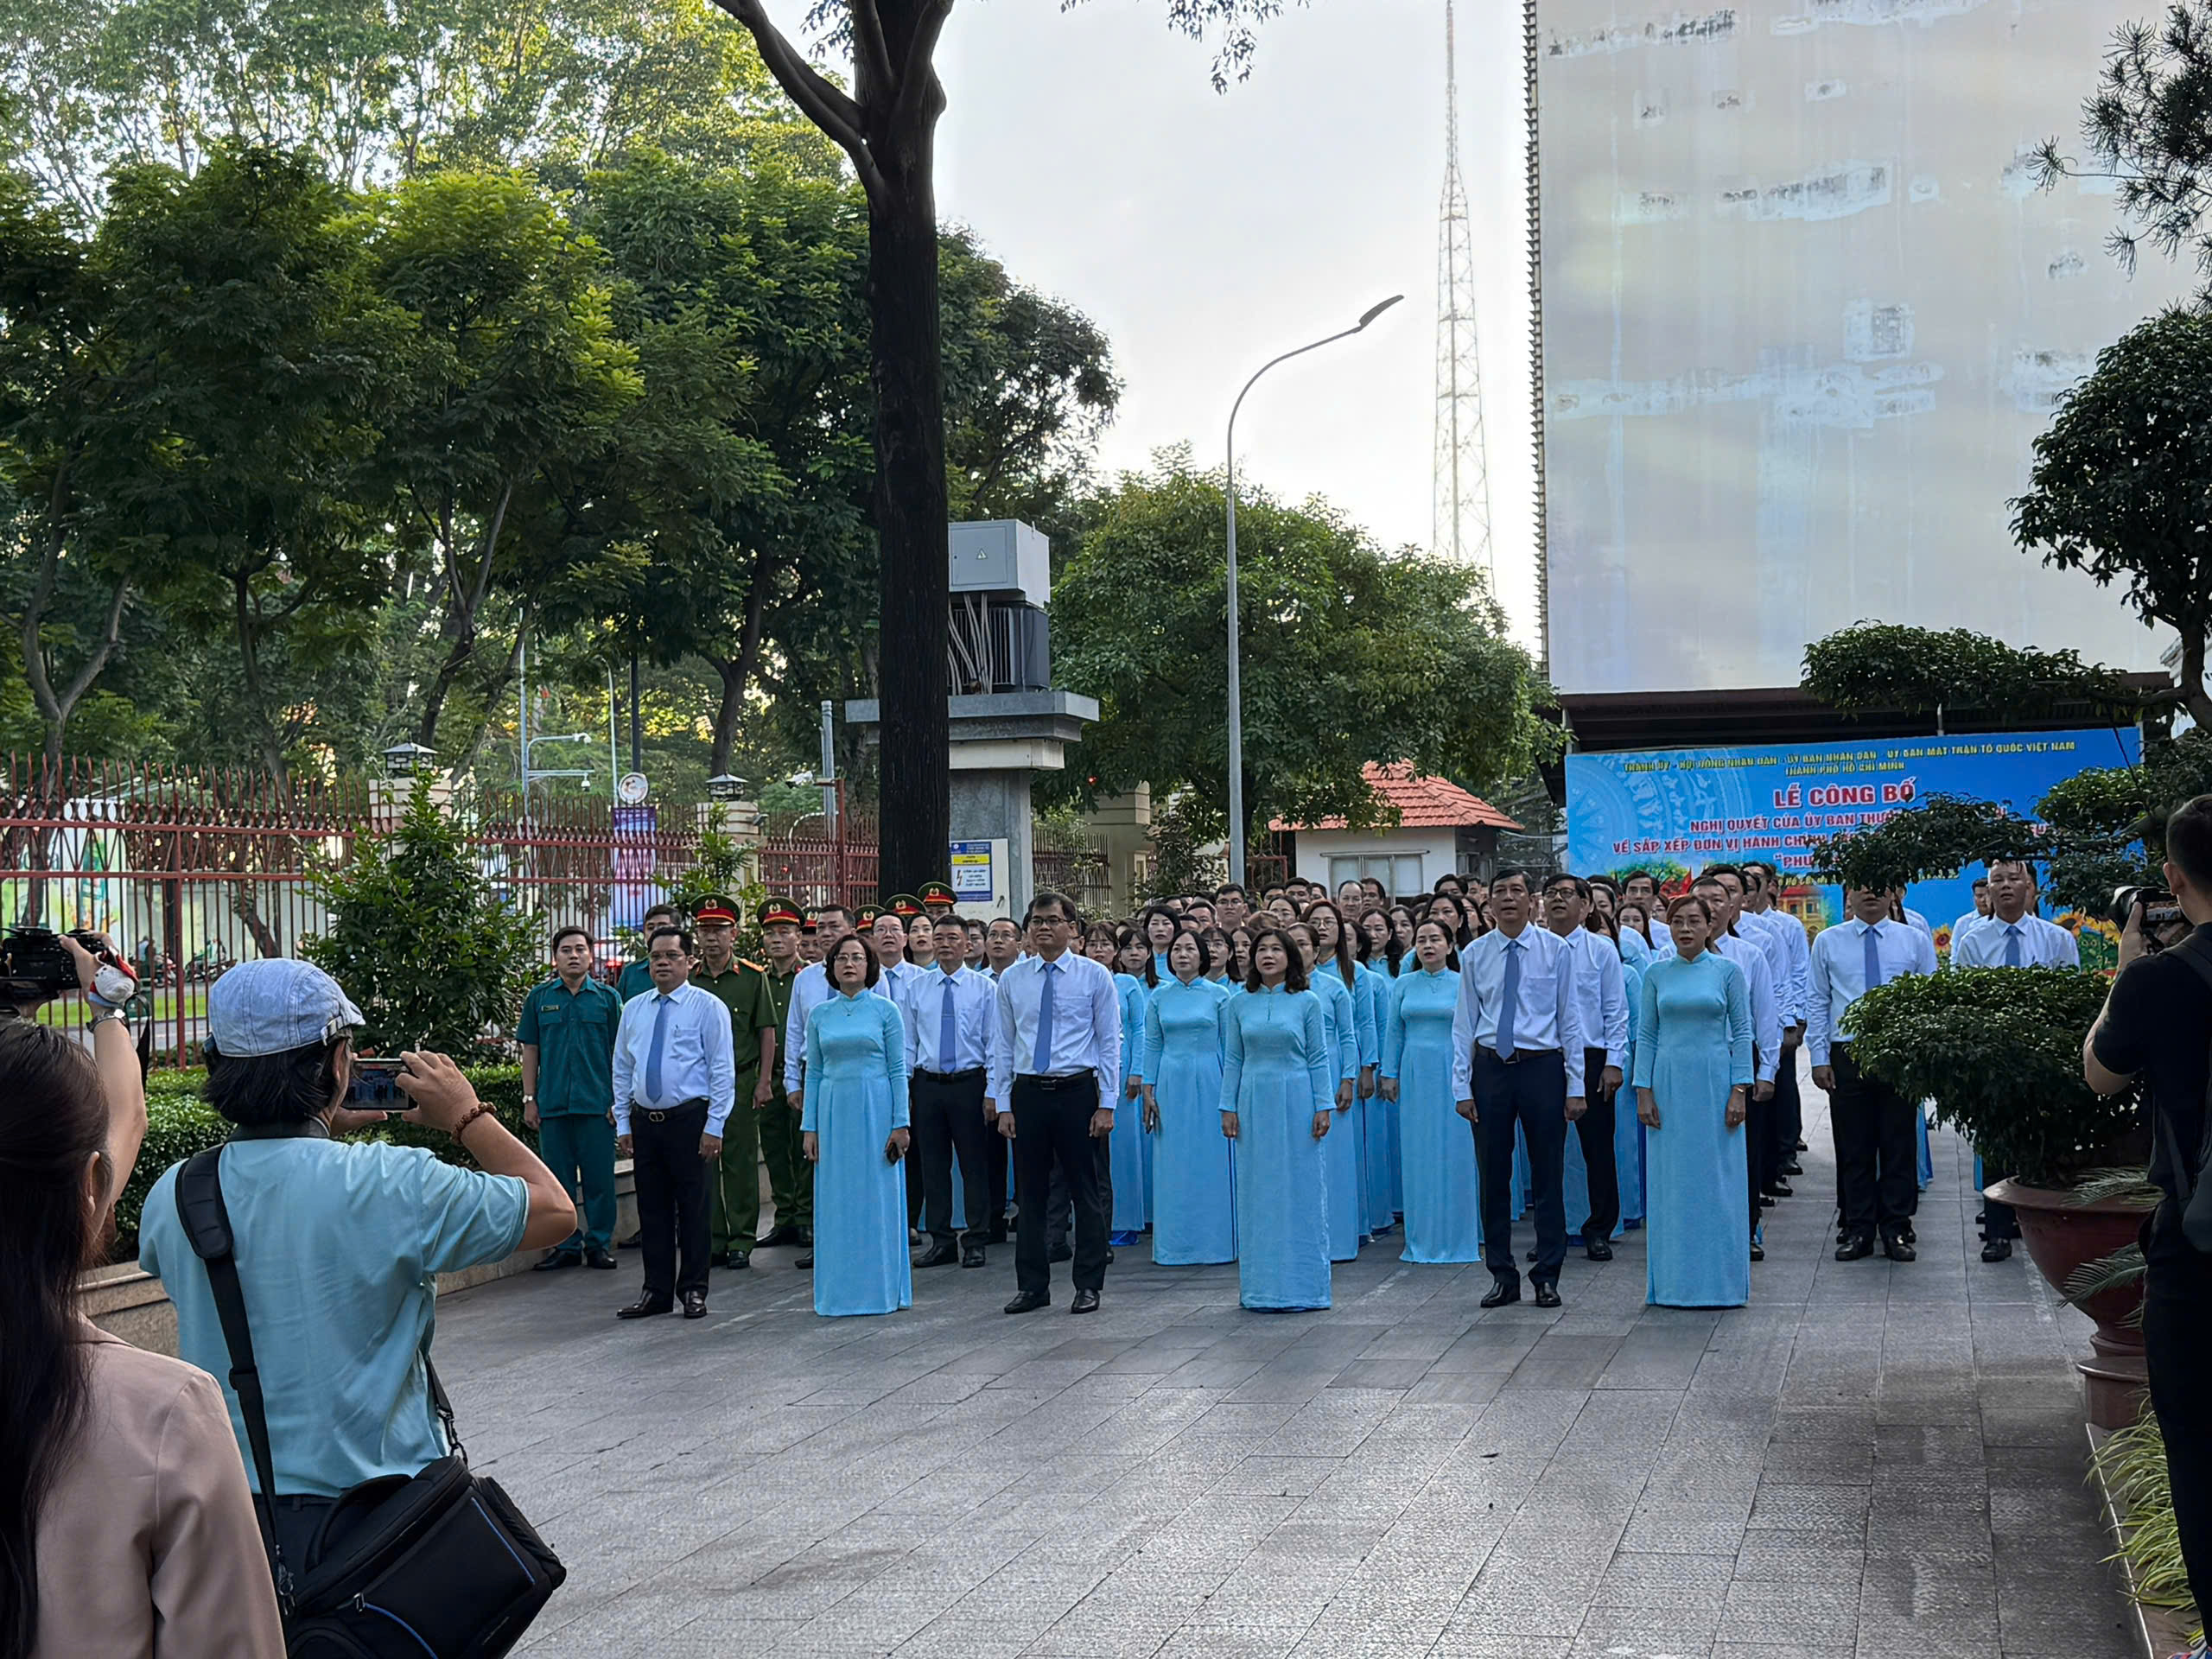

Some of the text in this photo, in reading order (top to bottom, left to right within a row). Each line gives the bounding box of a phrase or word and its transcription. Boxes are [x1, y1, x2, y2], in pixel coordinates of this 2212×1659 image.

[2051, 741, 2075, 752] NAM
[1774, 776, 1916, 808] LỄ CÔNG BỐ
[1689, 818, 1724, 835] NGHỊ
[1727, 815, 1770, 832] QUYẾT
[1773, 812, 1801, 829] CỦA
[1804, 810, 1823, 827] ỦY
[1827, 812, 1855, 826] BAN
[1612, 838, 1631, 854] VỀ
[1664, 836, 1689, 853] XẾP
[1694, 836, 1723, 851] ĐƠN
[1726, 836, 1740, 853] VỊ
[1743, 834, 1780, 849] HÀNH
